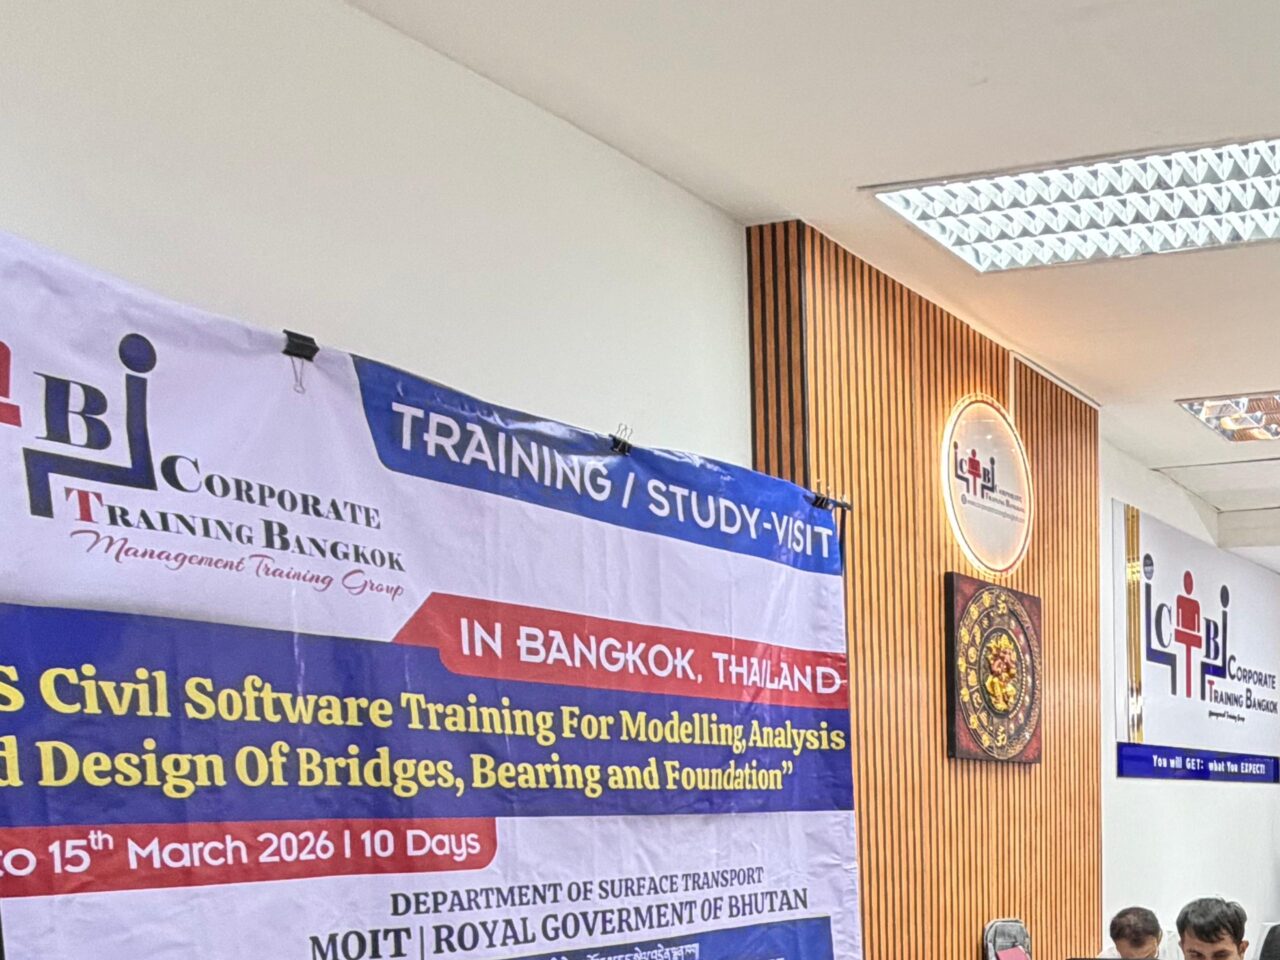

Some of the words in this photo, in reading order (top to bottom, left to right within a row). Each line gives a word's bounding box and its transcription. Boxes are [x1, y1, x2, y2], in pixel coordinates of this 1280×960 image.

[160, 455, 381, 529] CORPORATE
[391, 402, 612, 501] TRAINING
[622, 478, 633, 508] /
[647, 479, 833, 558] STUDY-VISIT
[65, 487, 253, 545] TRAINING
[262, 519, 405, 572] BANGKOK
[70, 530, 245, 572] Management
[249, 555, 333, 592] Training
[342, 570, 404, 599] Group
[460, 618, 502, 658] IN
[516, 627, 702, 683] BANGKOK,
[712, 652, 841, 693] THAILAND
[1228, 654, 1276, 690] CORPORATE
[39, 664, 172, 718] Civil
[184, 675, 394, 728] Software
[400, 692, 553, 746] Training
[562, 706, 613, 741] For
[621, 710, 746, 753] Modelling,
[749, 721, 845, 756] Analysis
[1207, 680, 1243, 708] TRAINING
[1245, 688, 1278, 714] BANGKOK
[36, 736, 227, 798] Design
[235, 741, 290, 788] Of
[297, 743, 465, 798] Bridges,
[471, 755, 602, 798] Bearing
[608, 758, 660, 791] and
[1153, 755, 1167, 767] You
[1170, 756, 1182, 768] will
[1209, 760, 1224, 771] what
[1226, 761, 1238, 772] You
[48, 830, 114, 873] 15th
[127, 832, 248, 869] March
[257, 831, 334, 863] 2026
[361, 830, 394, 857] 10
[406, 829, 480, 862] Days
[390, 882, 562, 916] DEPARTMENT
[567, 881, 593, 902] OF
[598, 874, 678, 900] SURFACE
[682, 866, 764, 892] TRANSPORT
[433, 917, 536, 954] ROYAL
[541, 899, 697, 942] GOVERMENT
[701, 897, 722, 922] OF
[728, 888, 808, 918] BHUTAN
